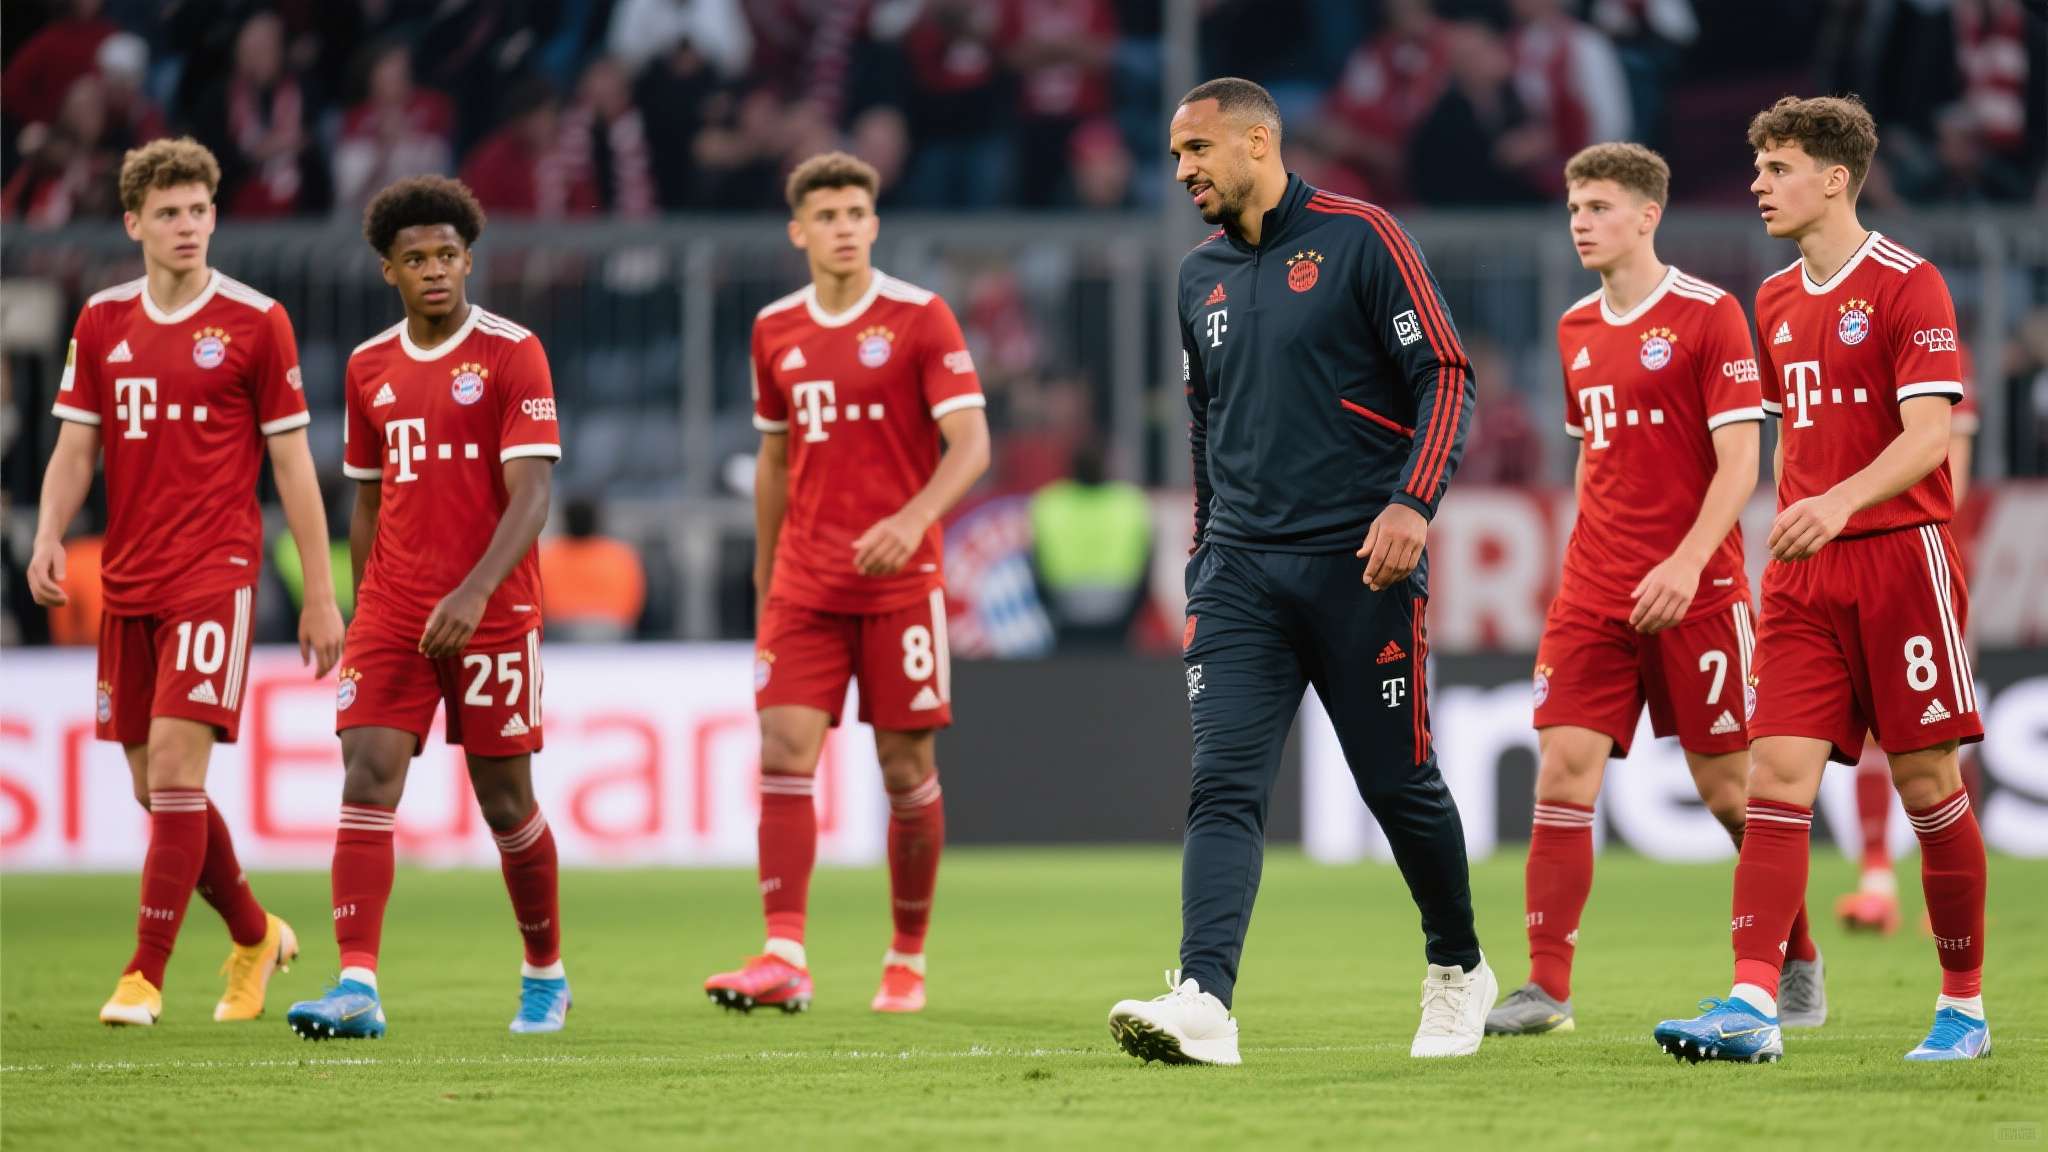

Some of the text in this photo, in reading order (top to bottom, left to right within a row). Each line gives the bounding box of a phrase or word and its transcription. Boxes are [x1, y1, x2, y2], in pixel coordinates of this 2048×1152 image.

[1207, 307, 1227, 347] T
[116, 378, 157, 439] T
[793, 381, 837, 442] T
[1578, 385, 1617, 449] T
[1784, 361, 1821, 428] T
[386, 418, 426, 482] T
[176, 621, 225, 674] 10
[903, 625, 934, 680] 8
[1904, 636, 1937, 691] 8
[464, 652, 522, 705] 25
[1383, 677, 1405, 707] T
